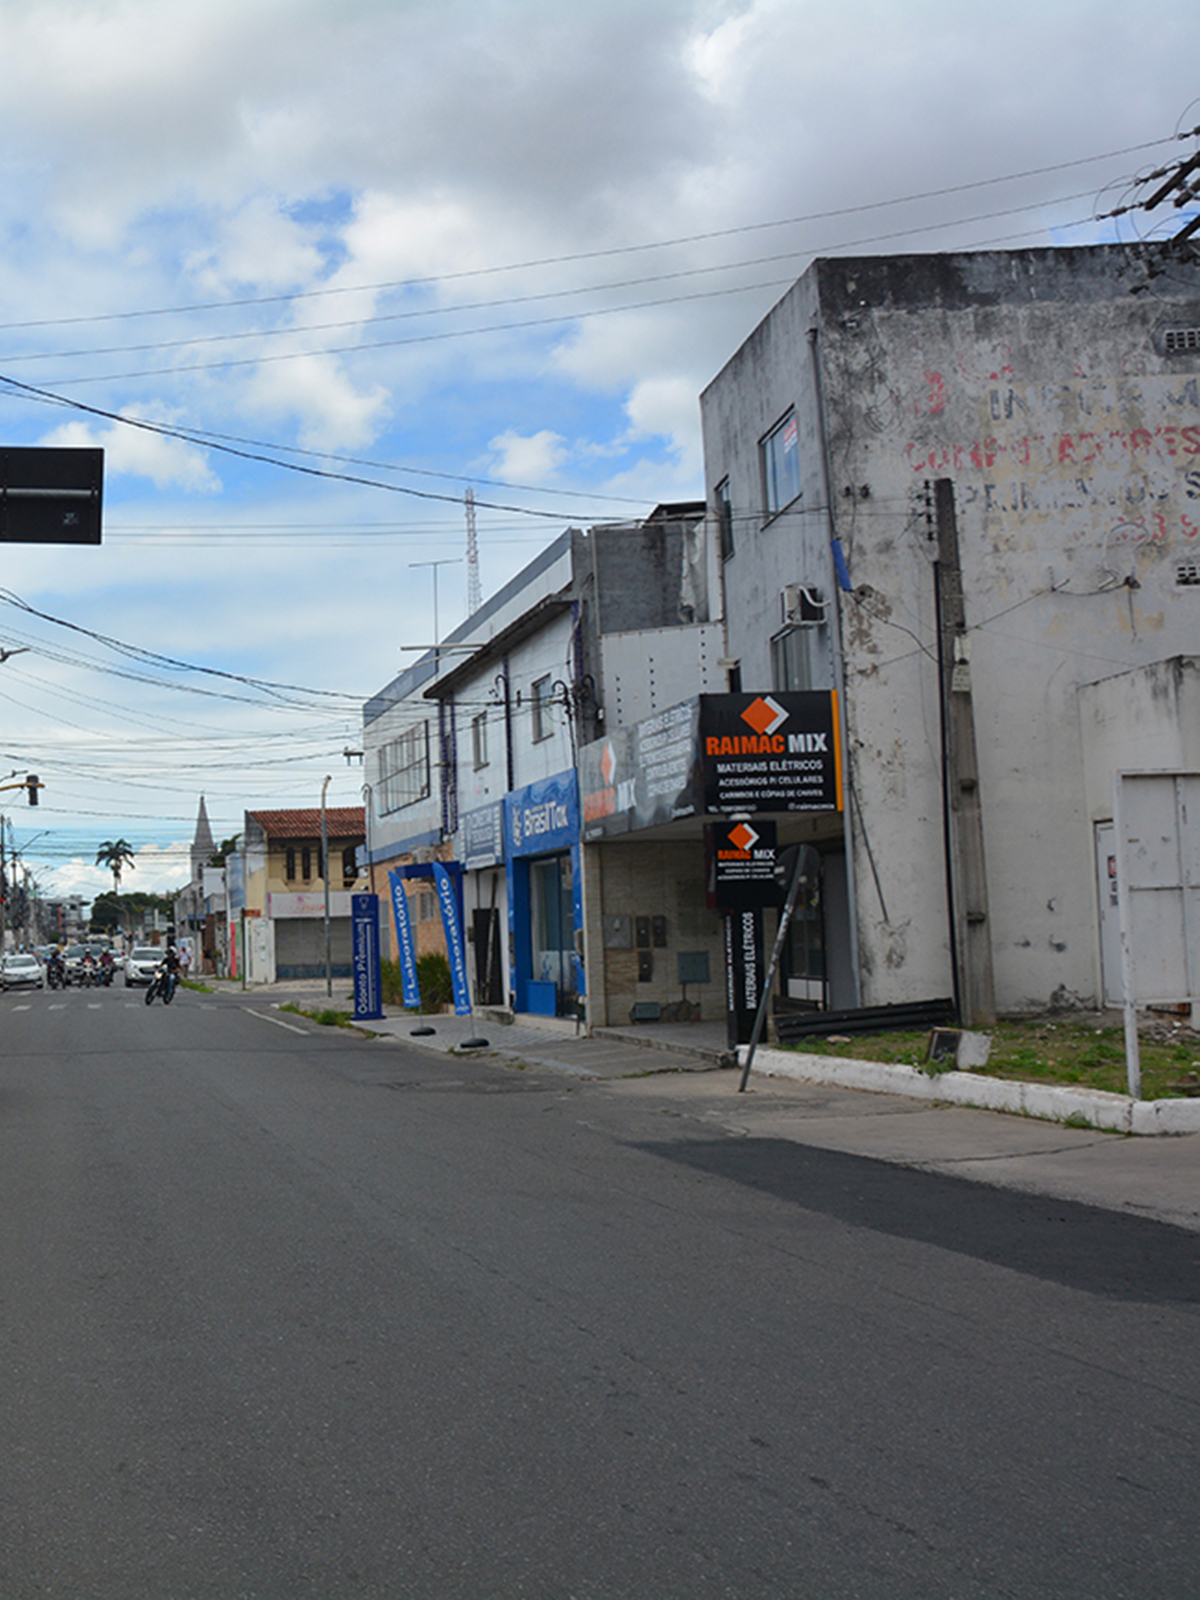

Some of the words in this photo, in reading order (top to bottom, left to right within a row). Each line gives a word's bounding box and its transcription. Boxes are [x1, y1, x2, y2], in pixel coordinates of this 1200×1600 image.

[706, 735, 785, 755] RAIMAC
[787, 733, 828, 753] MIX
[717, 762, 768, 773] MATERIAIS
[770, 759, 823, 772] ELÉTRICOS
[754, 848, 776, 860] MIX
[394, 885, 416, 989] Laboratório
[440, 878, 466, 995] Laboratório
[742, 912, 755, 961] ELÉTRICOS
[358, 973, 368, 1015] Odonto
[744, 962, 757, 1009] MATERIAIS
